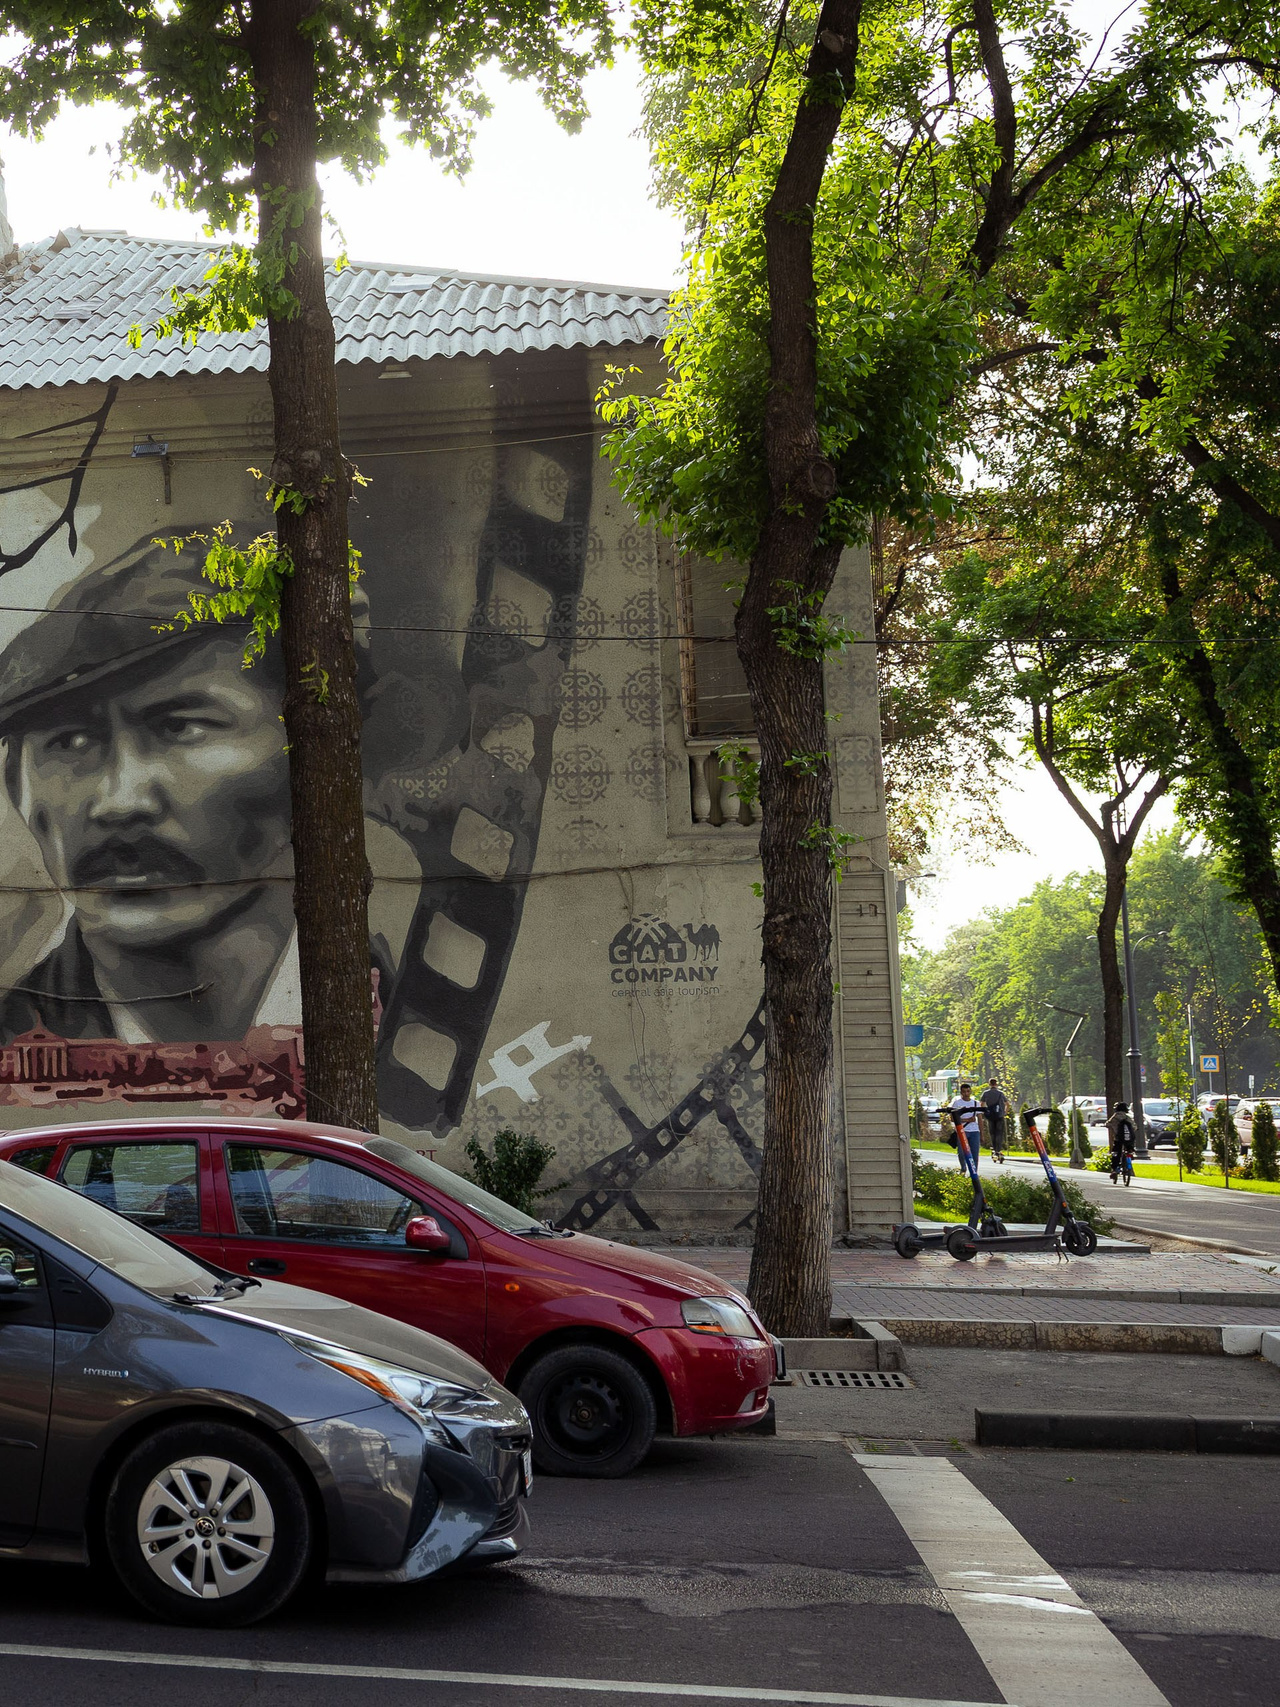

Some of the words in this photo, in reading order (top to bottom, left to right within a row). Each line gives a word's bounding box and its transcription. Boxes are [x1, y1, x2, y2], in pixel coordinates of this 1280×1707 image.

[612, 942, 683, 962] CAT
[610, 966, 719, 984] COMPANY
[611, 987, 651, 997] central
[653, 988, 673, 997] asia
[677, 986, 720, 996] tourism
[83, 1367, 122, 1378] HYBRID
